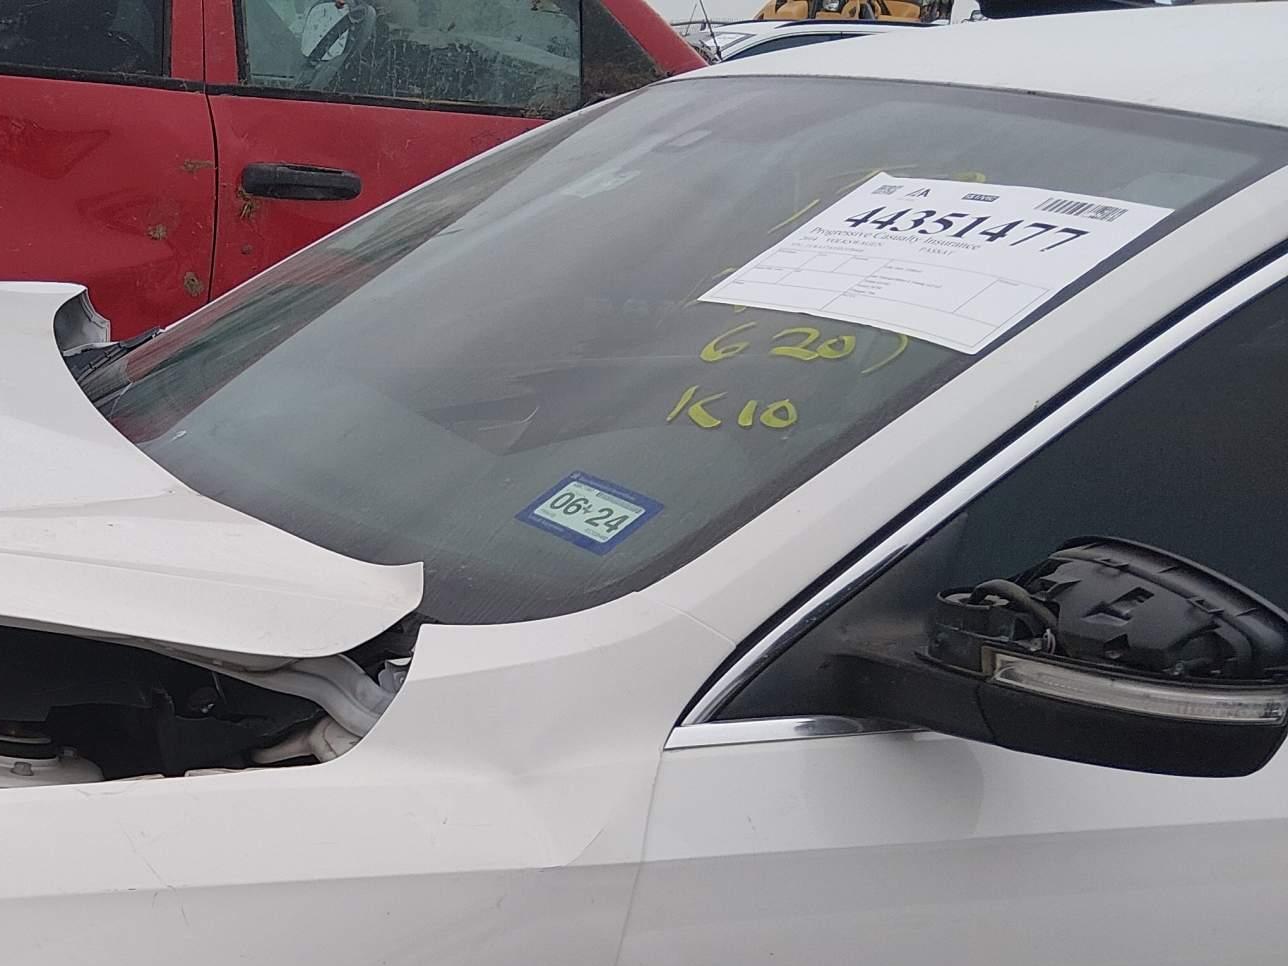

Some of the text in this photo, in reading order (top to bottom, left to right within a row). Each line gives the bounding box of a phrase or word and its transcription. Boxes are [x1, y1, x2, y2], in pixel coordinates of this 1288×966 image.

[811, 226, 982, 250] Progressive Casualty Insurance
[844, 206, 1090, 251] 44351477
[549, 492, 590, 516] 06
[583, 507, 630, 534] 24
